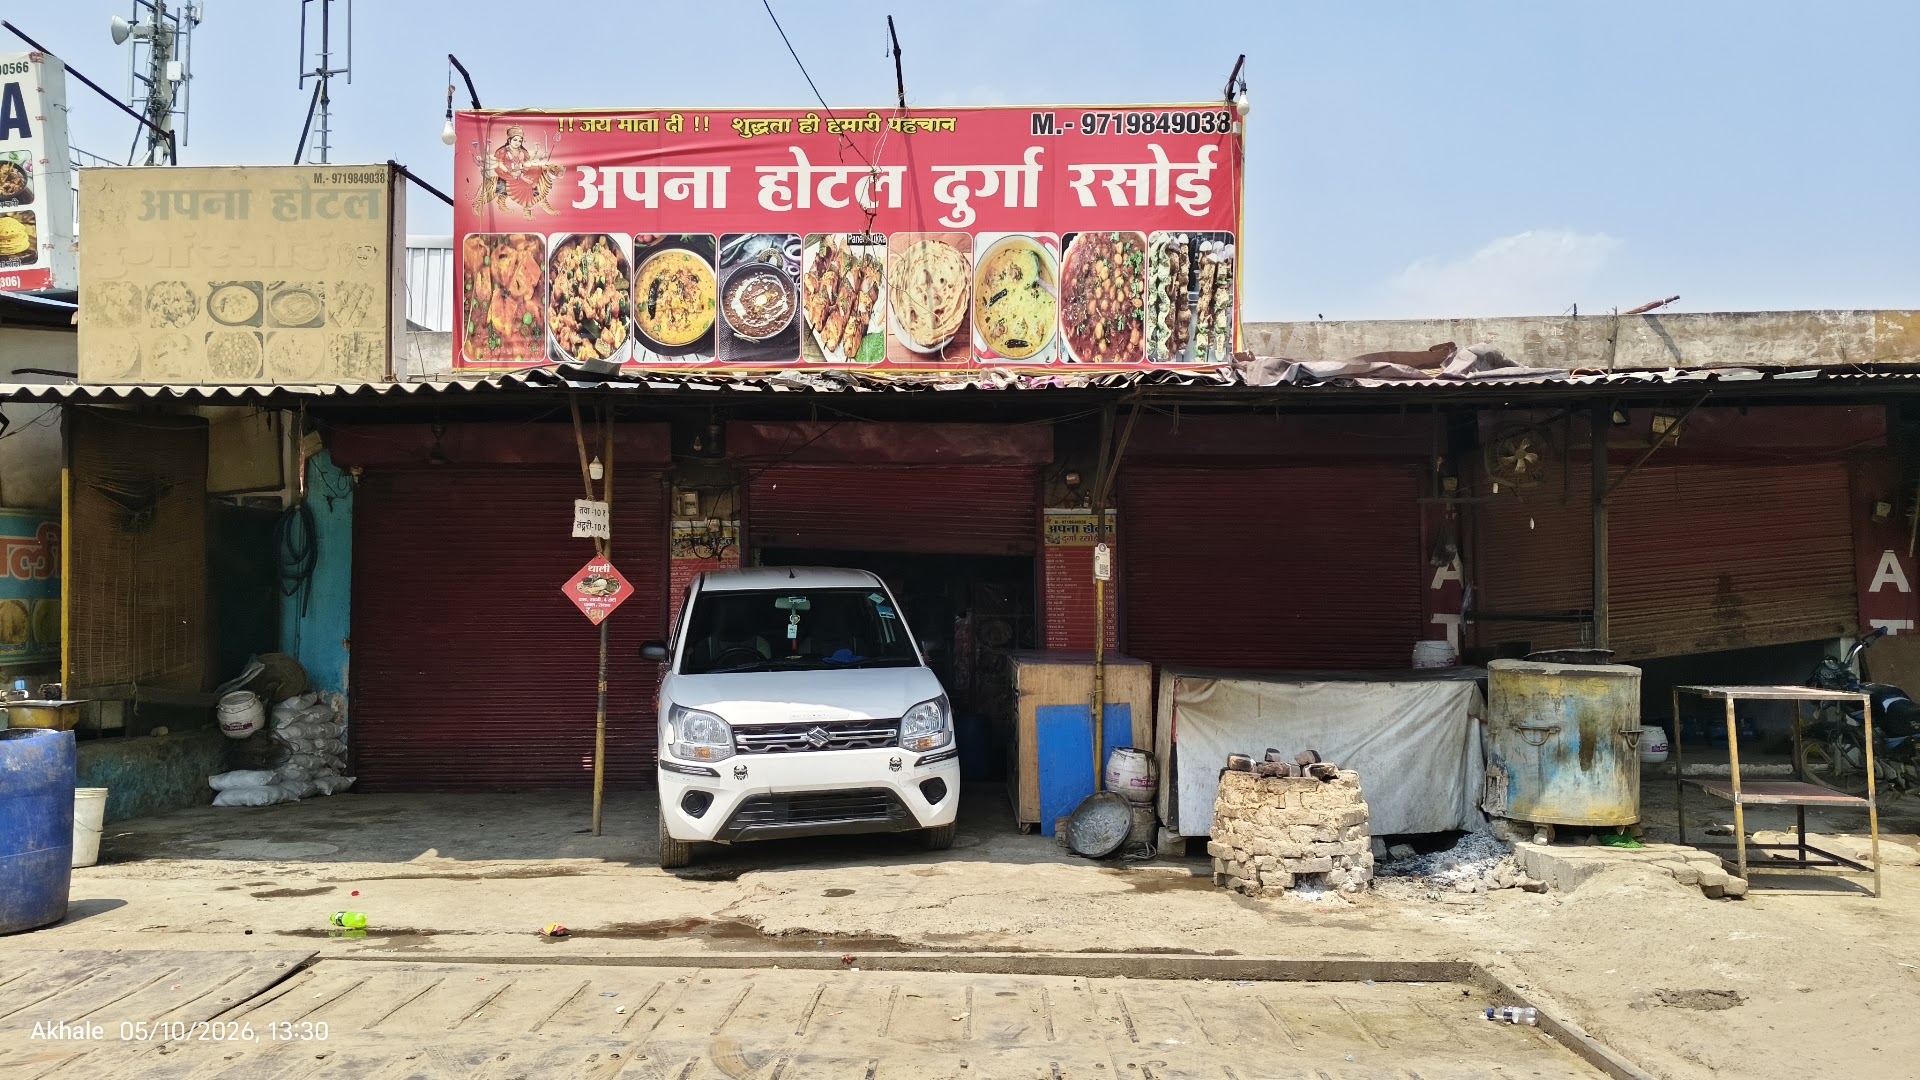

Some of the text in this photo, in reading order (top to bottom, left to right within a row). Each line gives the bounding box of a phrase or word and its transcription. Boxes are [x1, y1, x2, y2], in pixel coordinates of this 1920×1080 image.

[0, 61, 29, 76] 0566
[578, 117, 613, 133] जय
[616, 117, 660, 133] माता
[664, 113, 684, 134] दी
[731, 116, 792, 139] शुद्धता
[797, 112, 821, 134] ही
[825, 111, 883, 135] हमारी
[887, 117, 957, 134] पहचान
[1081, 110, 1232, 136] 9719849038
[331, 172, 385, 184] 9719849038
[572, 143, 1219, 228] अपना होटल दुर्गा रसोई
[137, 175, 382, 222] अपना होटल
[579, 506, 590, 515] तवा
[1048, 524, 1079, 533] अपना
[588, 563, 611, 573] थाली
